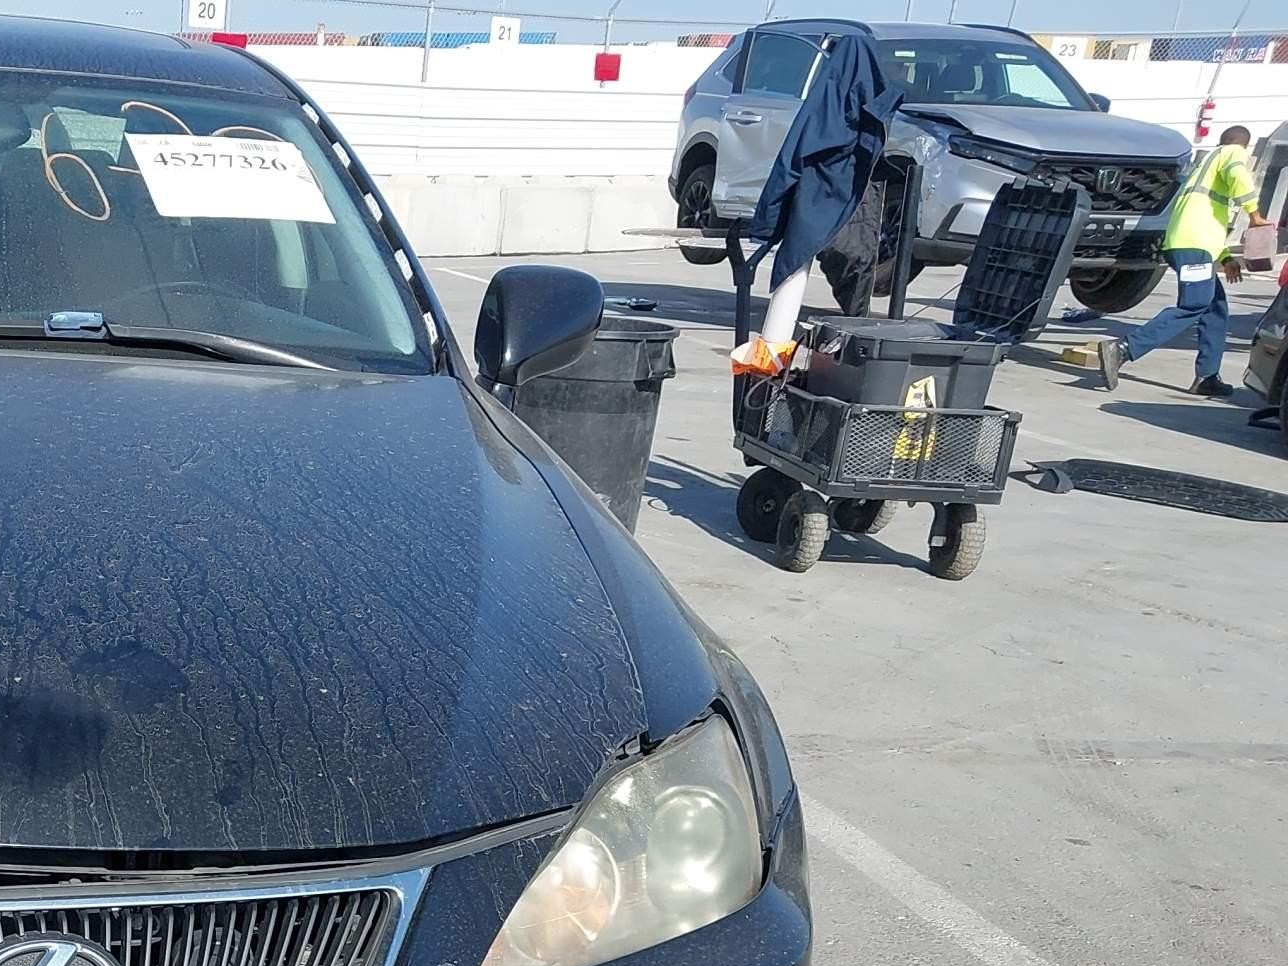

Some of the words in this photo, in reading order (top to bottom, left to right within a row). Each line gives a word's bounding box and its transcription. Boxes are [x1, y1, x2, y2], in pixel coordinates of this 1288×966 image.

[198, 1, 216, 20] 20
[498, 25, 512, 41] 21
[1058, 43, 1078, 57] 23
[152, 151, 288, 172] 45277326
